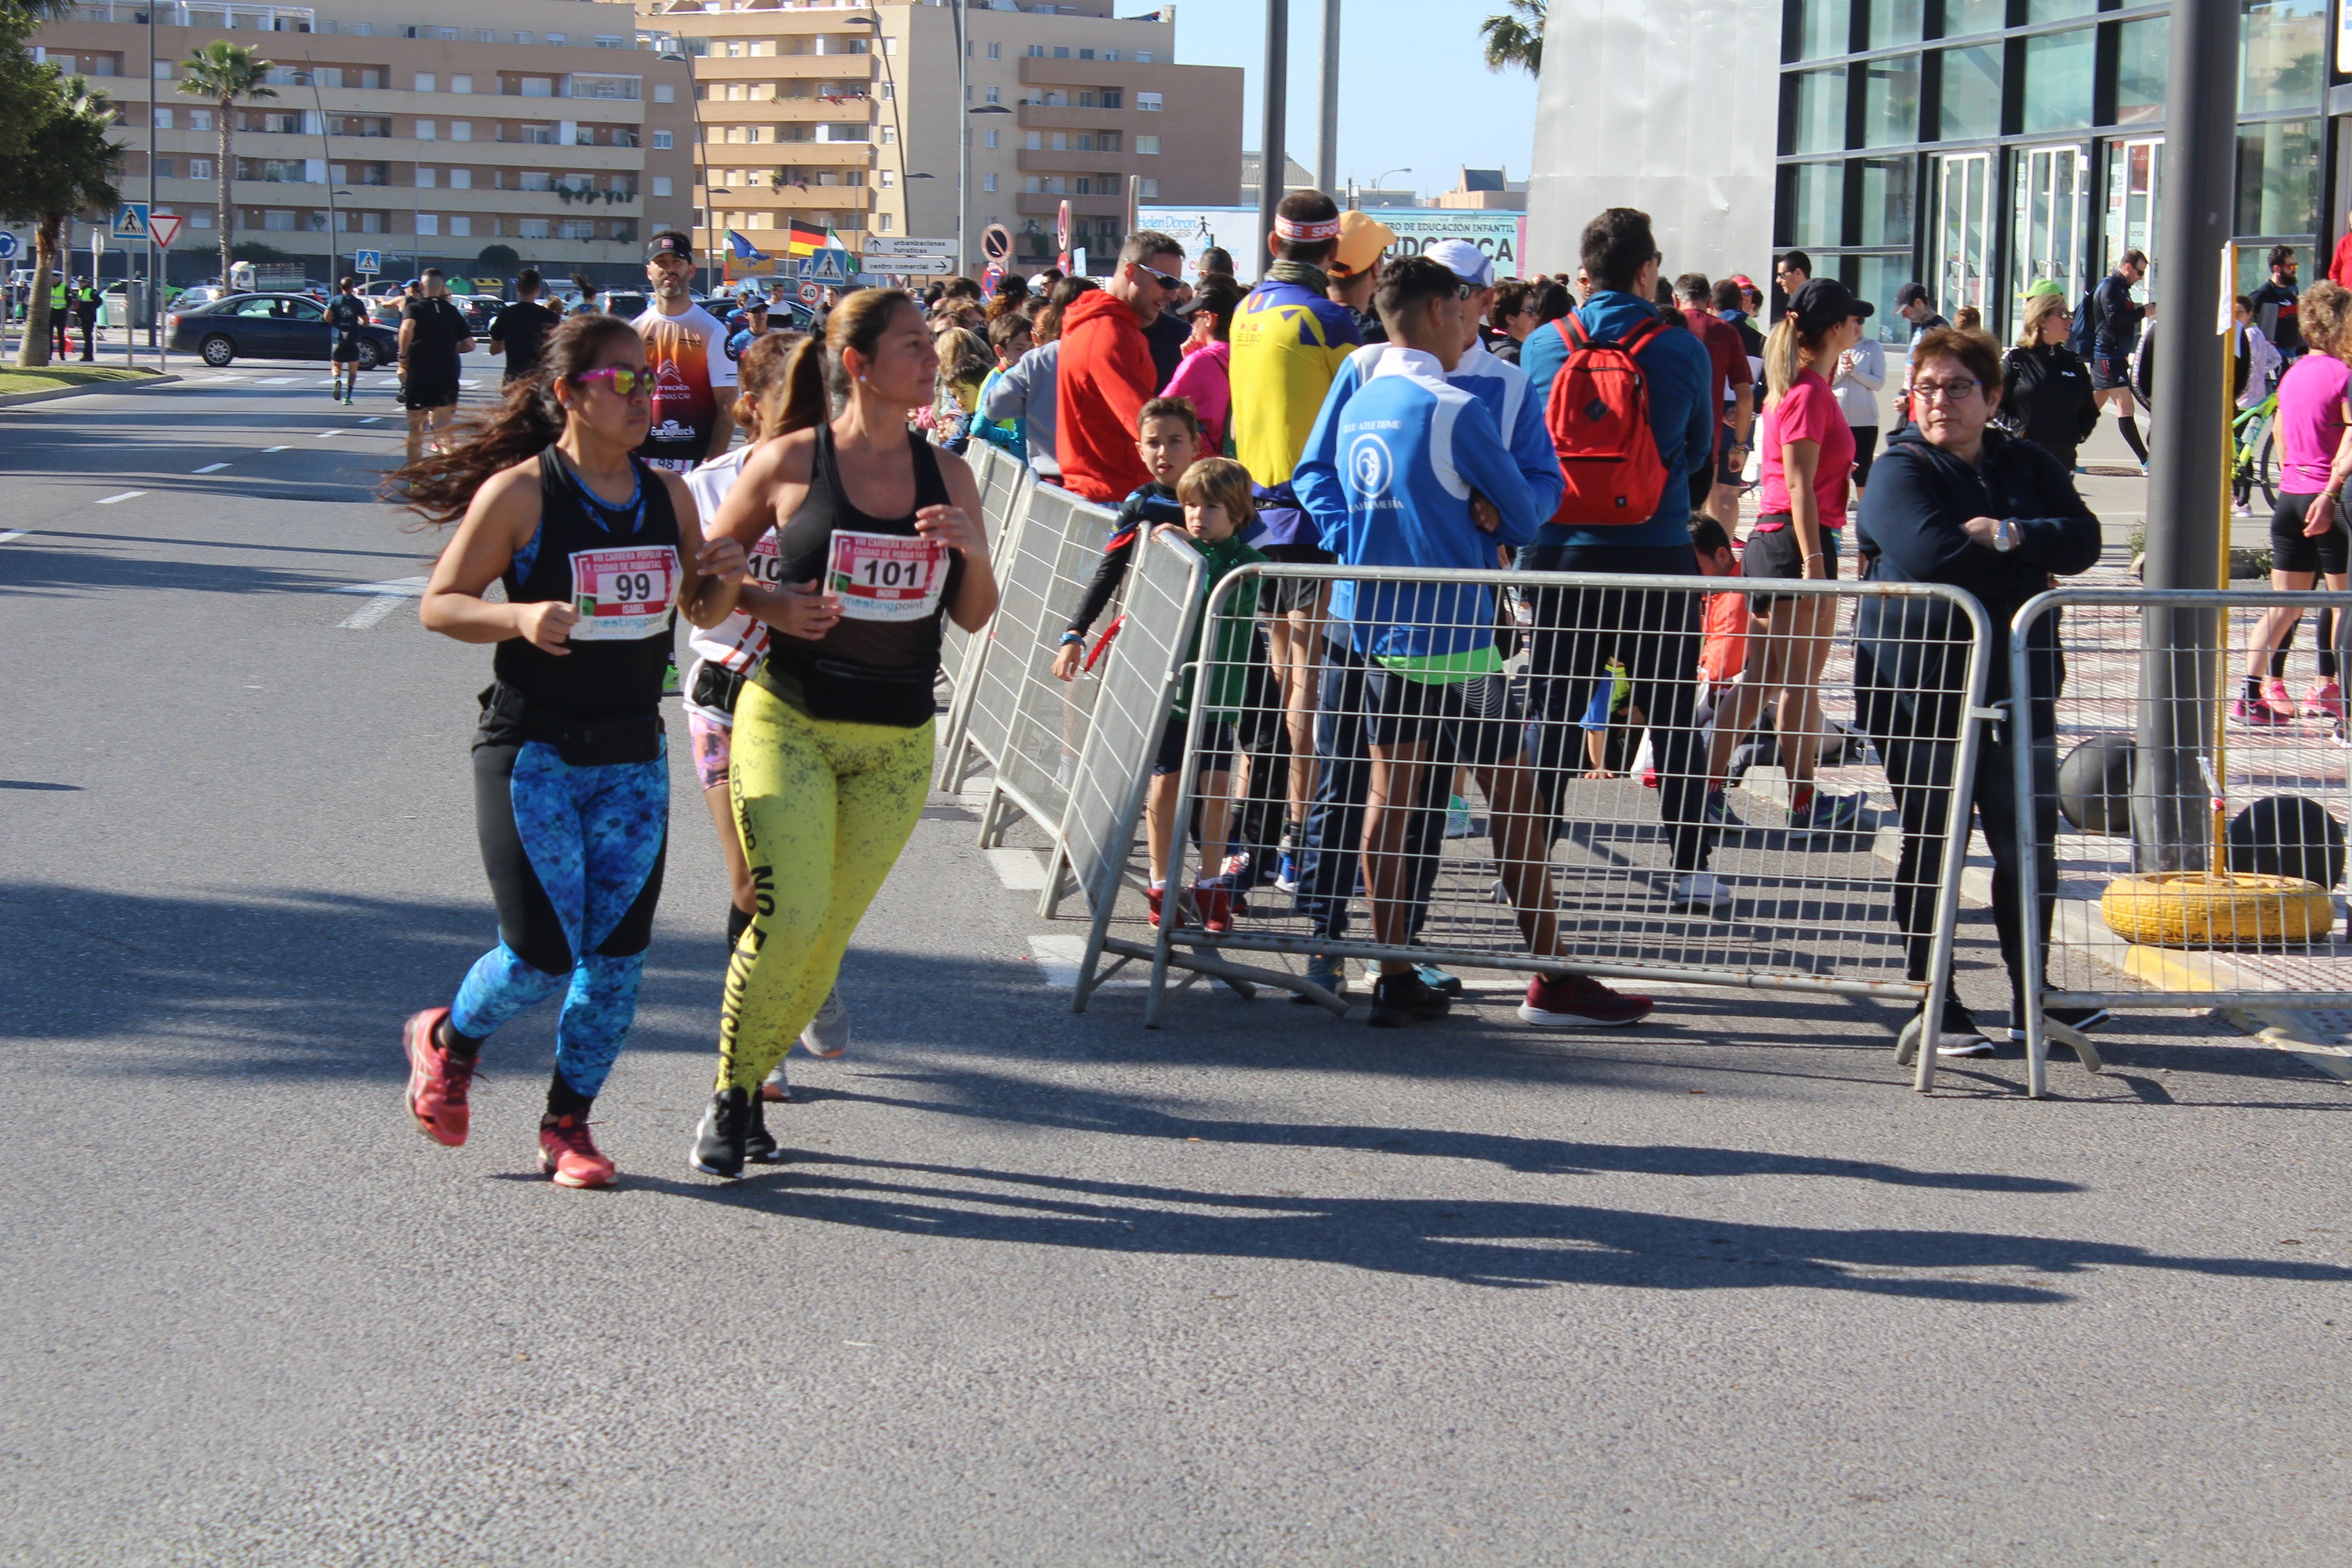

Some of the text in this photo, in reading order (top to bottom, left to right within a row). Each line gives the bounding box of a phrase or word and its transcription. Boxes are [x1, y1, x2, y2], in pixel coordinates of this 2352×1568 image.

[1165, 216, 1196, 229] Doron
[1384, 222, 1516, 233] TRO DE EDUCACIÓN INFANTIL
[1384, 236, 1514, 262] UDCA
[802, 288, 816, 298] 40
[868, 538, 900, 549] CARRERA
[901, 540, 930, 550] POPULAR
[605, 551, 636, 562] CARRERA
[854, 546, 928, 559] CIUDAD DE ROQUETAS
[593, 560, 662, 572] CIUDAD DE ROQUETAS
[864, 559, 918, 587] 101
[616, 572, 651, 602] 99
[876, 588, 900, 599] INGRID
[622, 603, 646, 615] ISABEL
[841, 596, 924, 612] meetingpoint
[730, 764, 757, 851] adidas
[751, 865, 775, 917] NO
